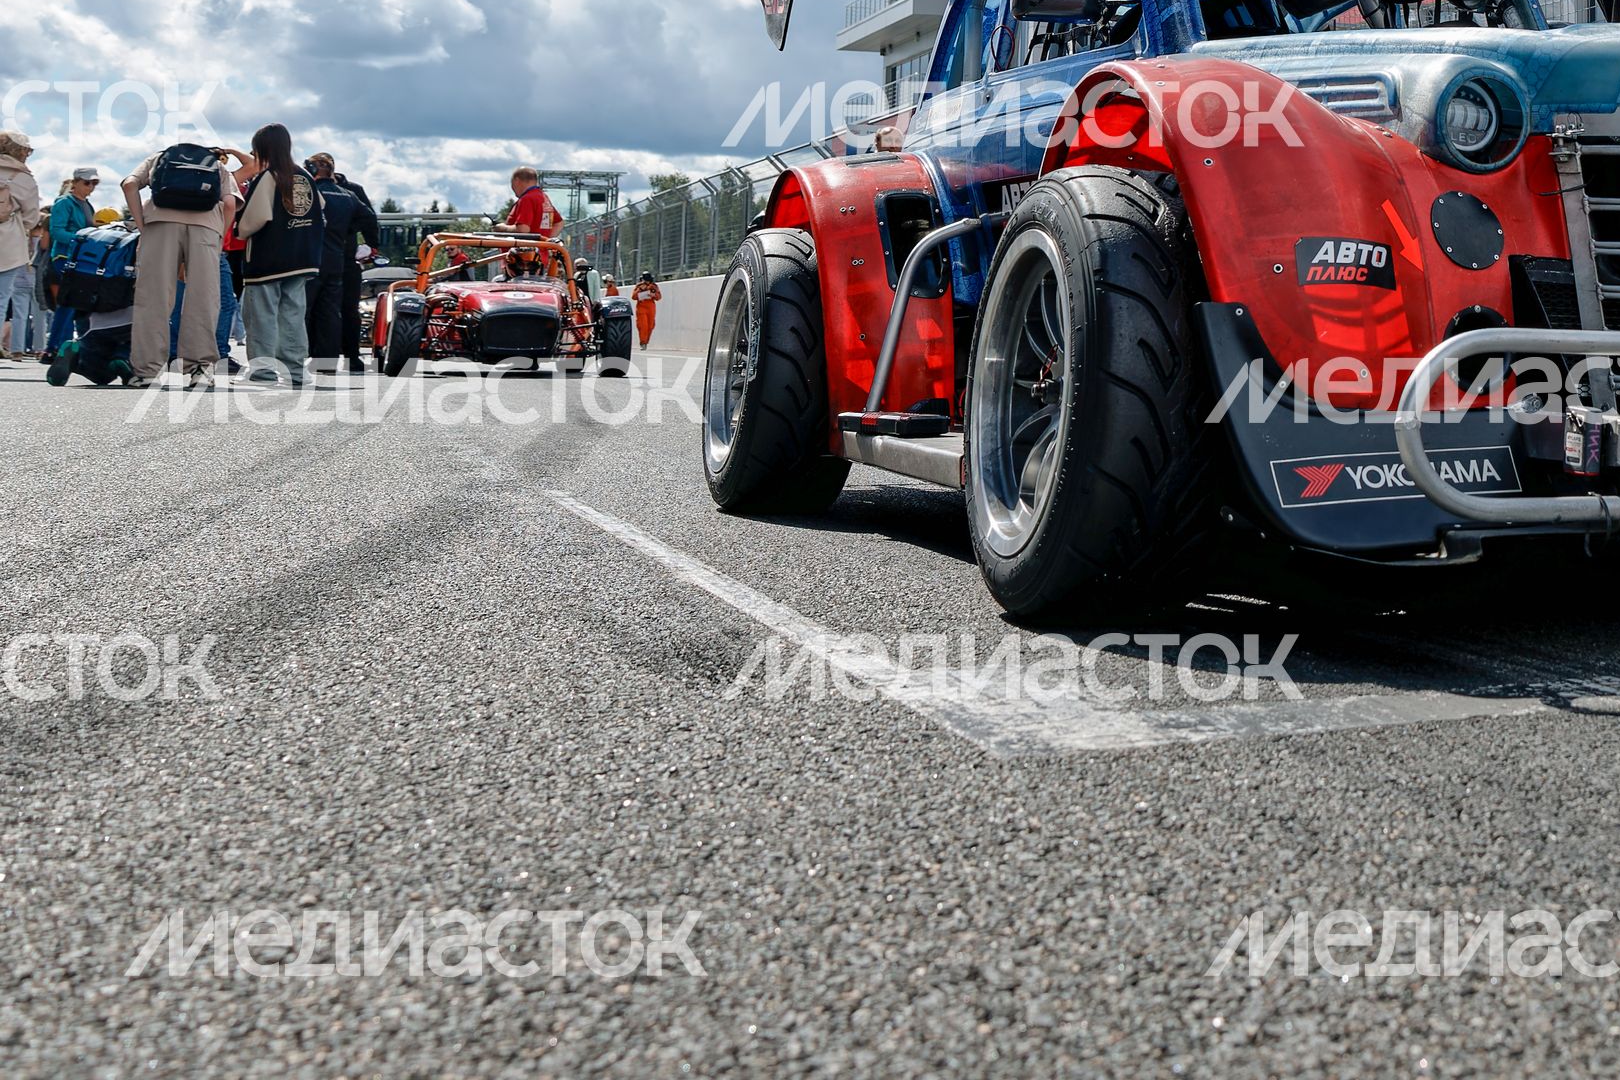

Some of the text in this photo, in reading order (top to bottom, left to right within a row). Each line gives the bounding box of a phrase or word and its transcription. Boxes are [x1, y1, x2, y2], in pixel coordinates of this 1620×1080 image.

[1450, 132, 1478, 144] LED
[1311, 241, 1388, 268] АВТО
[1306, 266, 1369, 282] ПЛЮС
[1344, 458, 1502, 490] YOKOAMA
